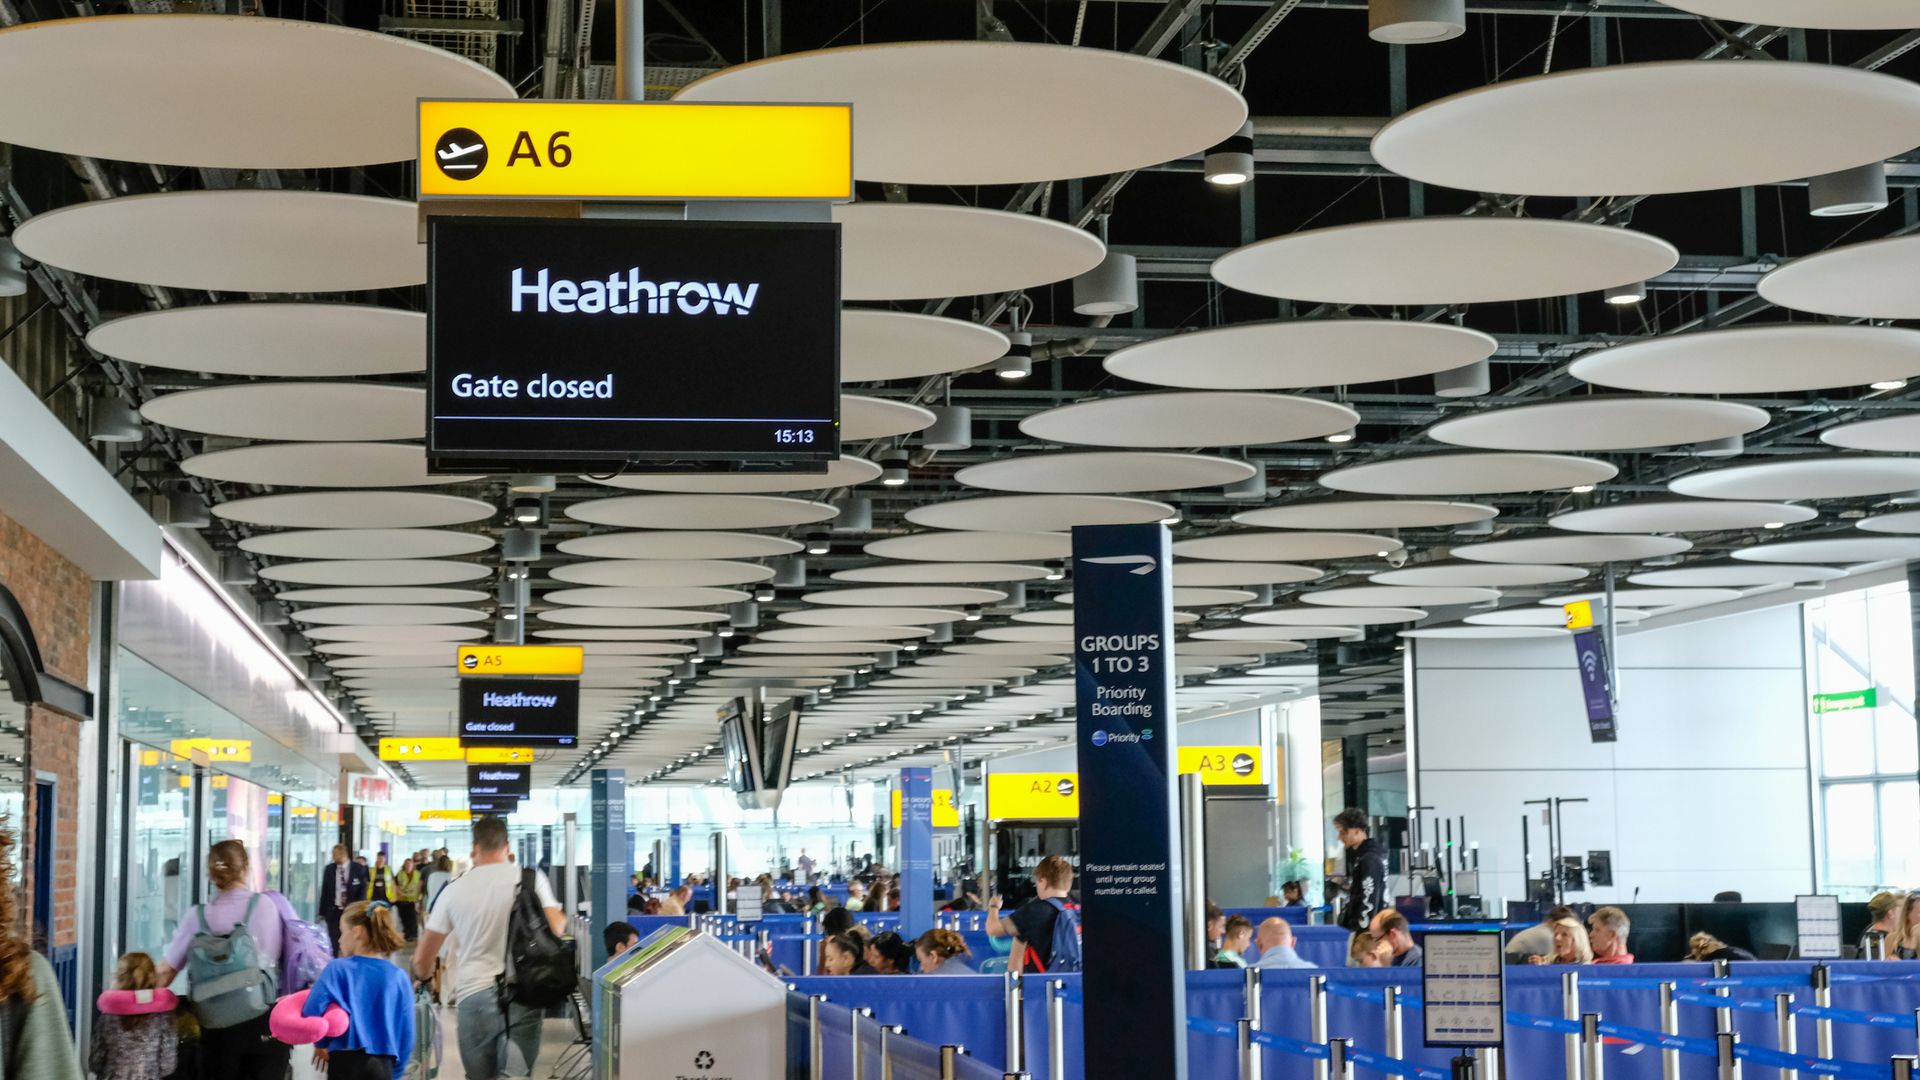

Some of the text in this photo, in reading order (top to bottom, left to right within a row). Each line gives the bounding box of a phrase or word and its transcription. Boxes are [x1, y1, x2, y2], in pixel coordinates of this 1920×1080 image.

[506, 130, 573, 168] A6
[510, 266, 760, 316] Heathrow
[450, 372, 614, 400] Gate closed
[774, 429, 814, 445] 15:13
[1081, 634, 1159, 652] GROUPS
[484, 656, 502, 666] A5
[1092, 656, 1150, 673] 1 TO 3
[482, 692, 558, 708] Heathrow
[1096, 685, 1146, 701] Priority
[1092, 702, 1153, 717] Boarding
[1108, 732, 1141, 744] Priority
[1199, 755, 1226, 771] A3
[1030, 780, 1052, 793] A2
[1086, 862, 1166, 872] Please remain seated
[1114, 876, 1132, 885] your
[1132, 875, 1157, 885] group
[1095, 887, 1124, 896] number
